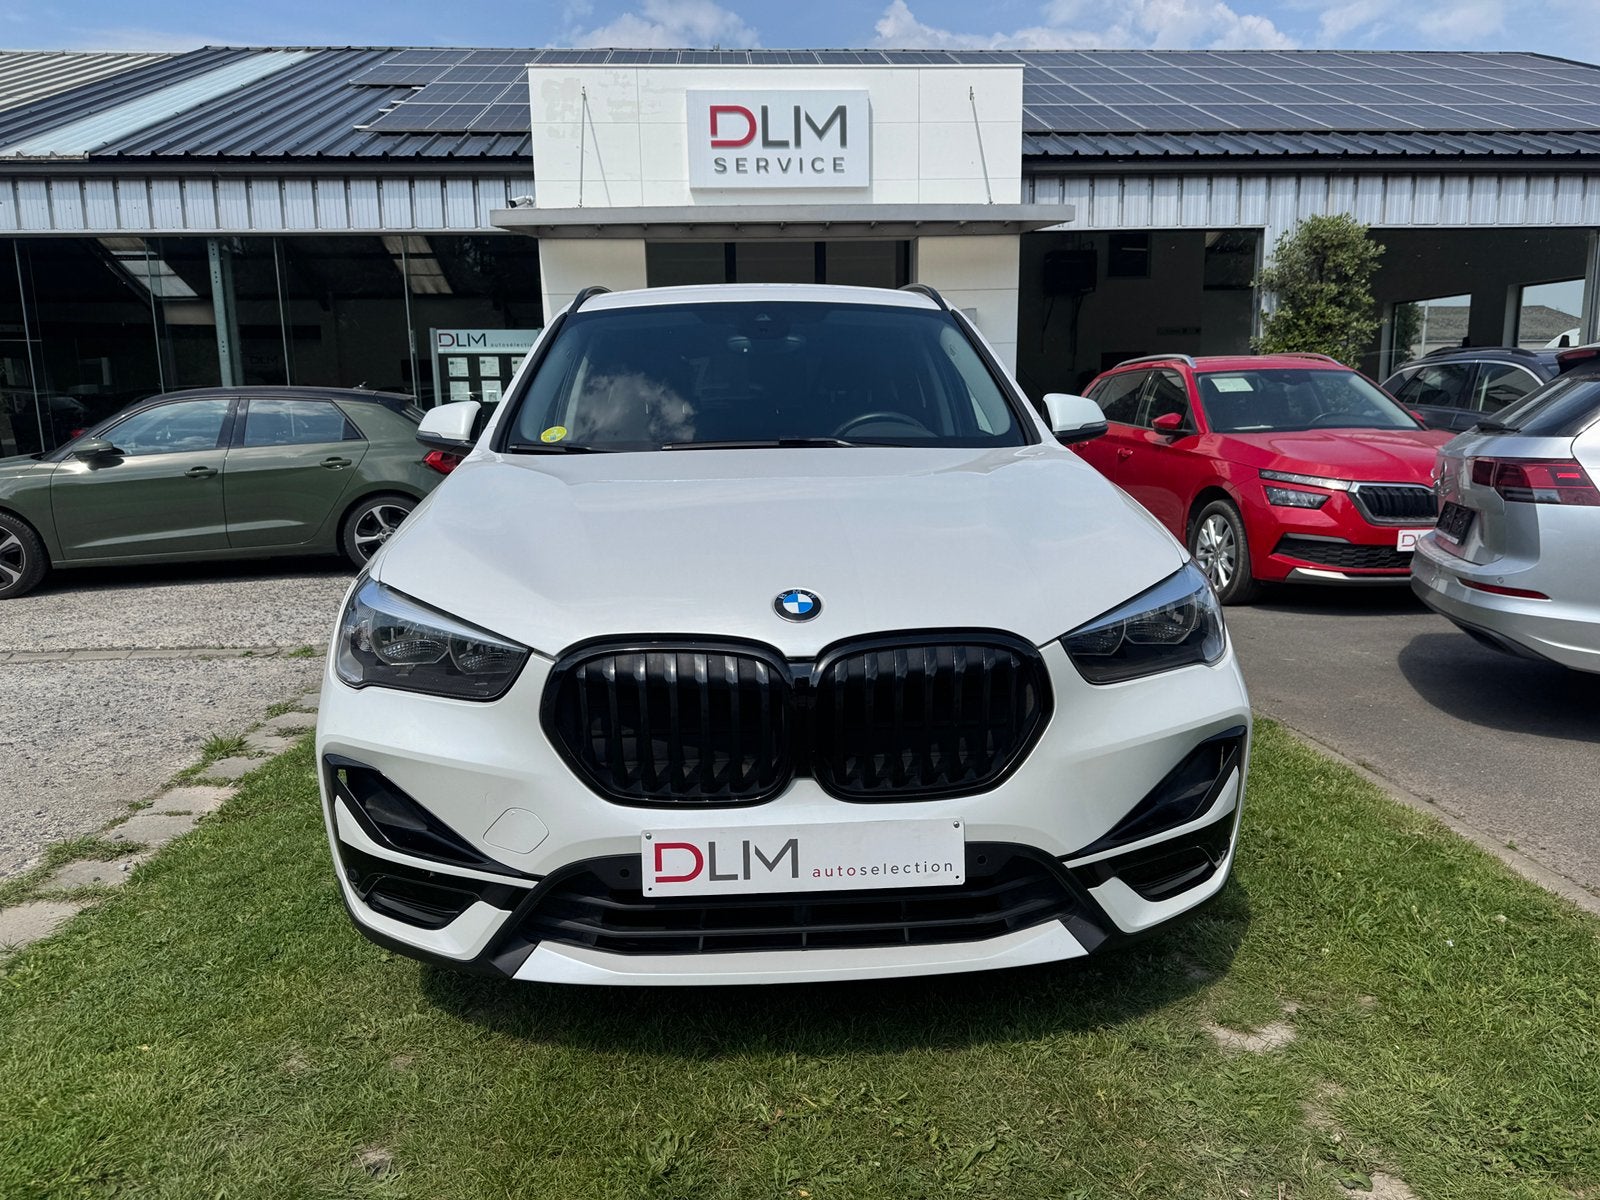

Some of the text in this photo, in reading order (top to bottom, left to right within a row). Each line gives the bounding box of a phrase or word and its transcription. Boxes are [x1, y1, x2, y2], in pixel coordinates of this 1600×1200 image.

[709, 105, 848, 149] DLM
[713, 156, 846, 174] SERVICE
[438, 333, 487, 348] DLM
[654, 838, 954, 883] DLM autoselection
